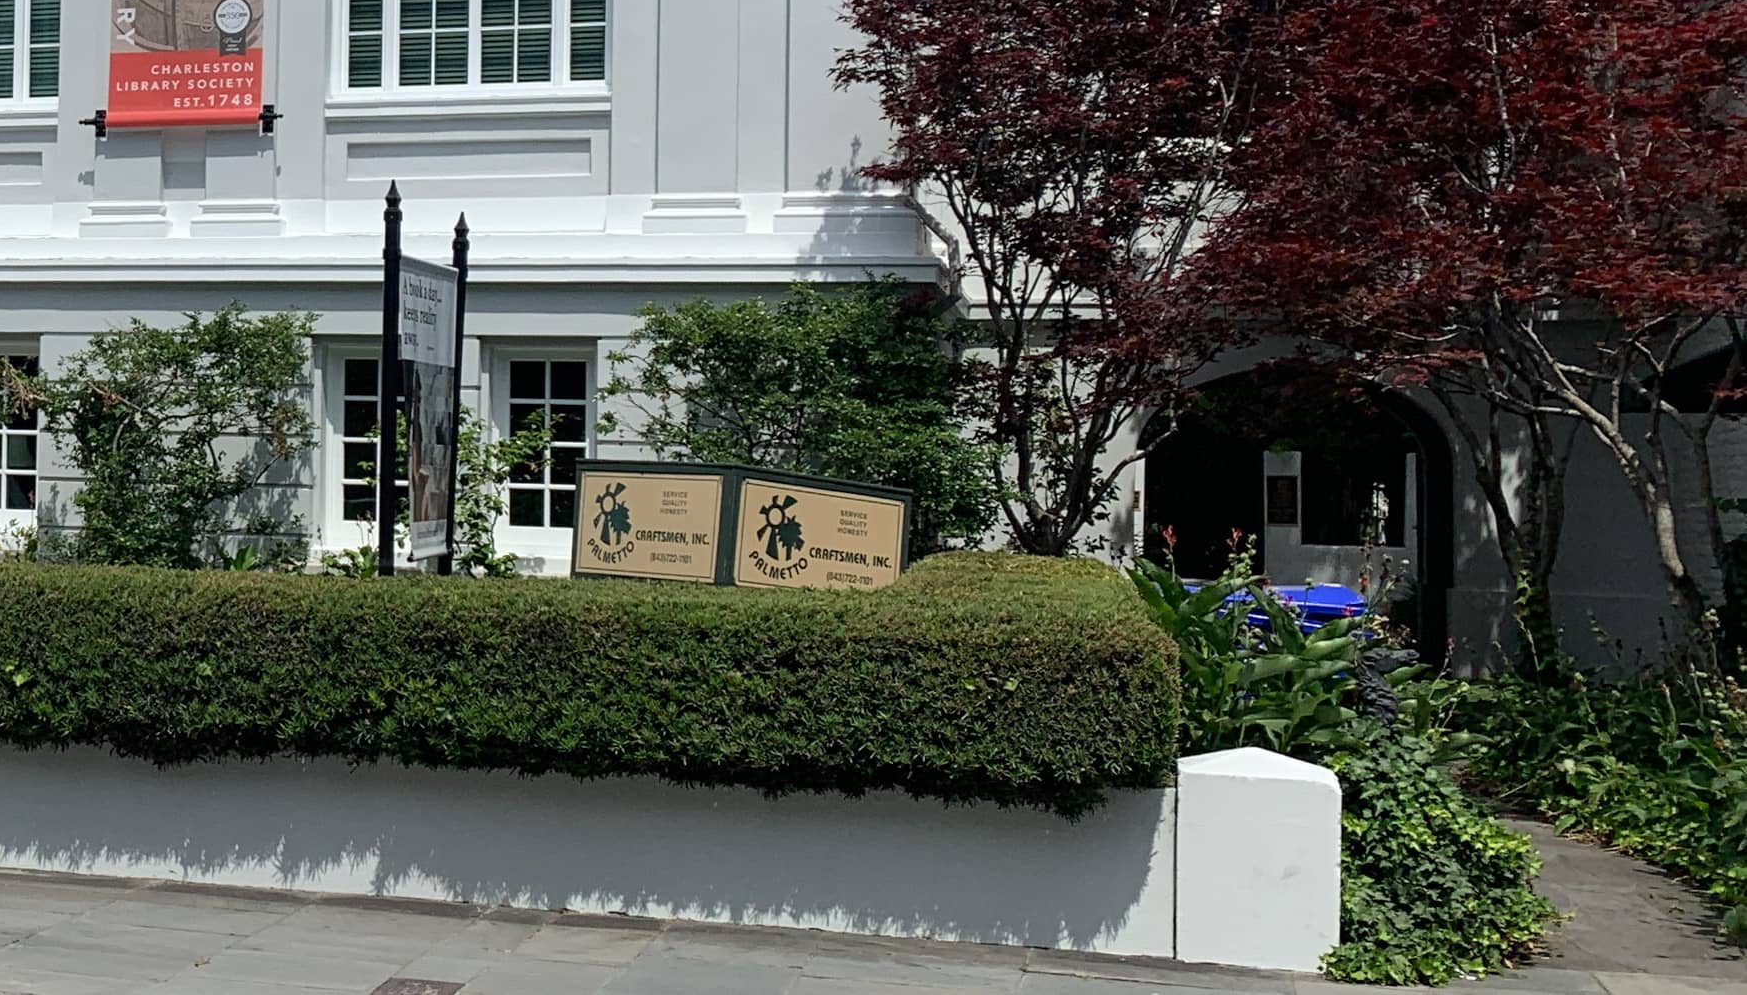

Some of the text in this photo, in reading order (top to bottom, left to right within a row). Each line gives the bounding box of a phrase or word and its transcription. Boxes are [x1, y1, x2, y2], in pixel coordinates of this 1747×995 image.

[151, 62, 254, 75] CHARLESTON
[116, 77, 254, 92] LIBRARY SOCIETY
[662, 491, 688, 499] SERVICE
[661, 499, 687, 507] QUALITY
[840, 510, 868, 520] SERVICE
[839, 519, 868, 528] QUALITY
[837, 527, 868, 537] HONESTY
[691, 533, 710, 546] INC.
[587, 537, 635, 564] PALMETTO
[748, 550, 809, 581] PALMETTO
[872, 555, 893, 569] INC.
